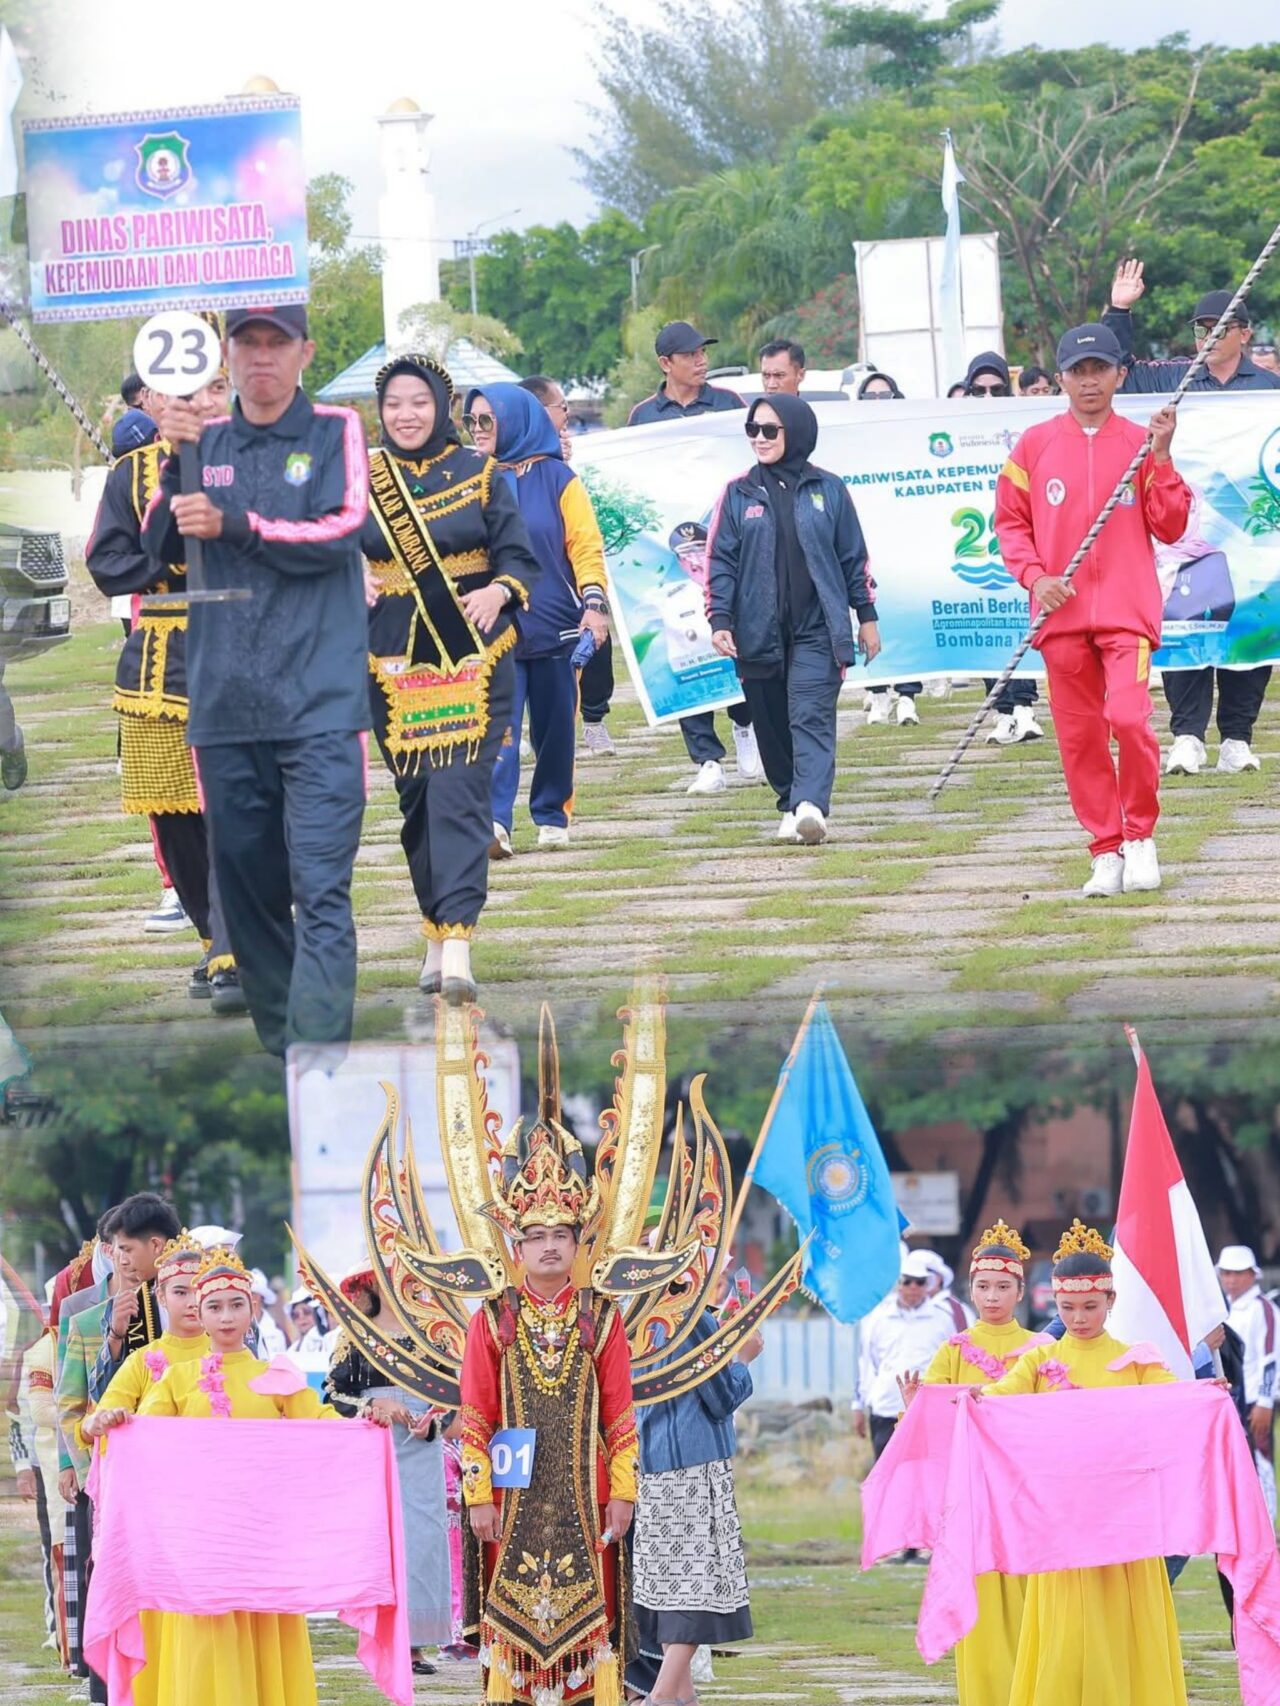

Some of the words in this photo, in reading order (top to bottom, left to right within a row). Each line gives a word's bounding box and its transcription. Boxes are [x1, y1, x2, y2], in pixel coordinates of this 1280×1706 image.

[61, 216, 127, 254] DINAS
[133, 204, 272, 248] PARIWISATA,
[45, 256, 158, 294] KEPEMUDAAN
[164, 251, 198, 285] DAN
[203, 245, 293, 282] OLAHRAGA
[148, 328, 208, 375] 23
[843, 469, 933, 485] PARIWISATA
[895, 481, 983, 497] KABUPATEN
[389, 512, 432, 576] BOMBANA
[932, 597, 984, 615] Berani
[935, 632, 1013, 648] Bombana
[491, 1443, 530, 1476] 01
